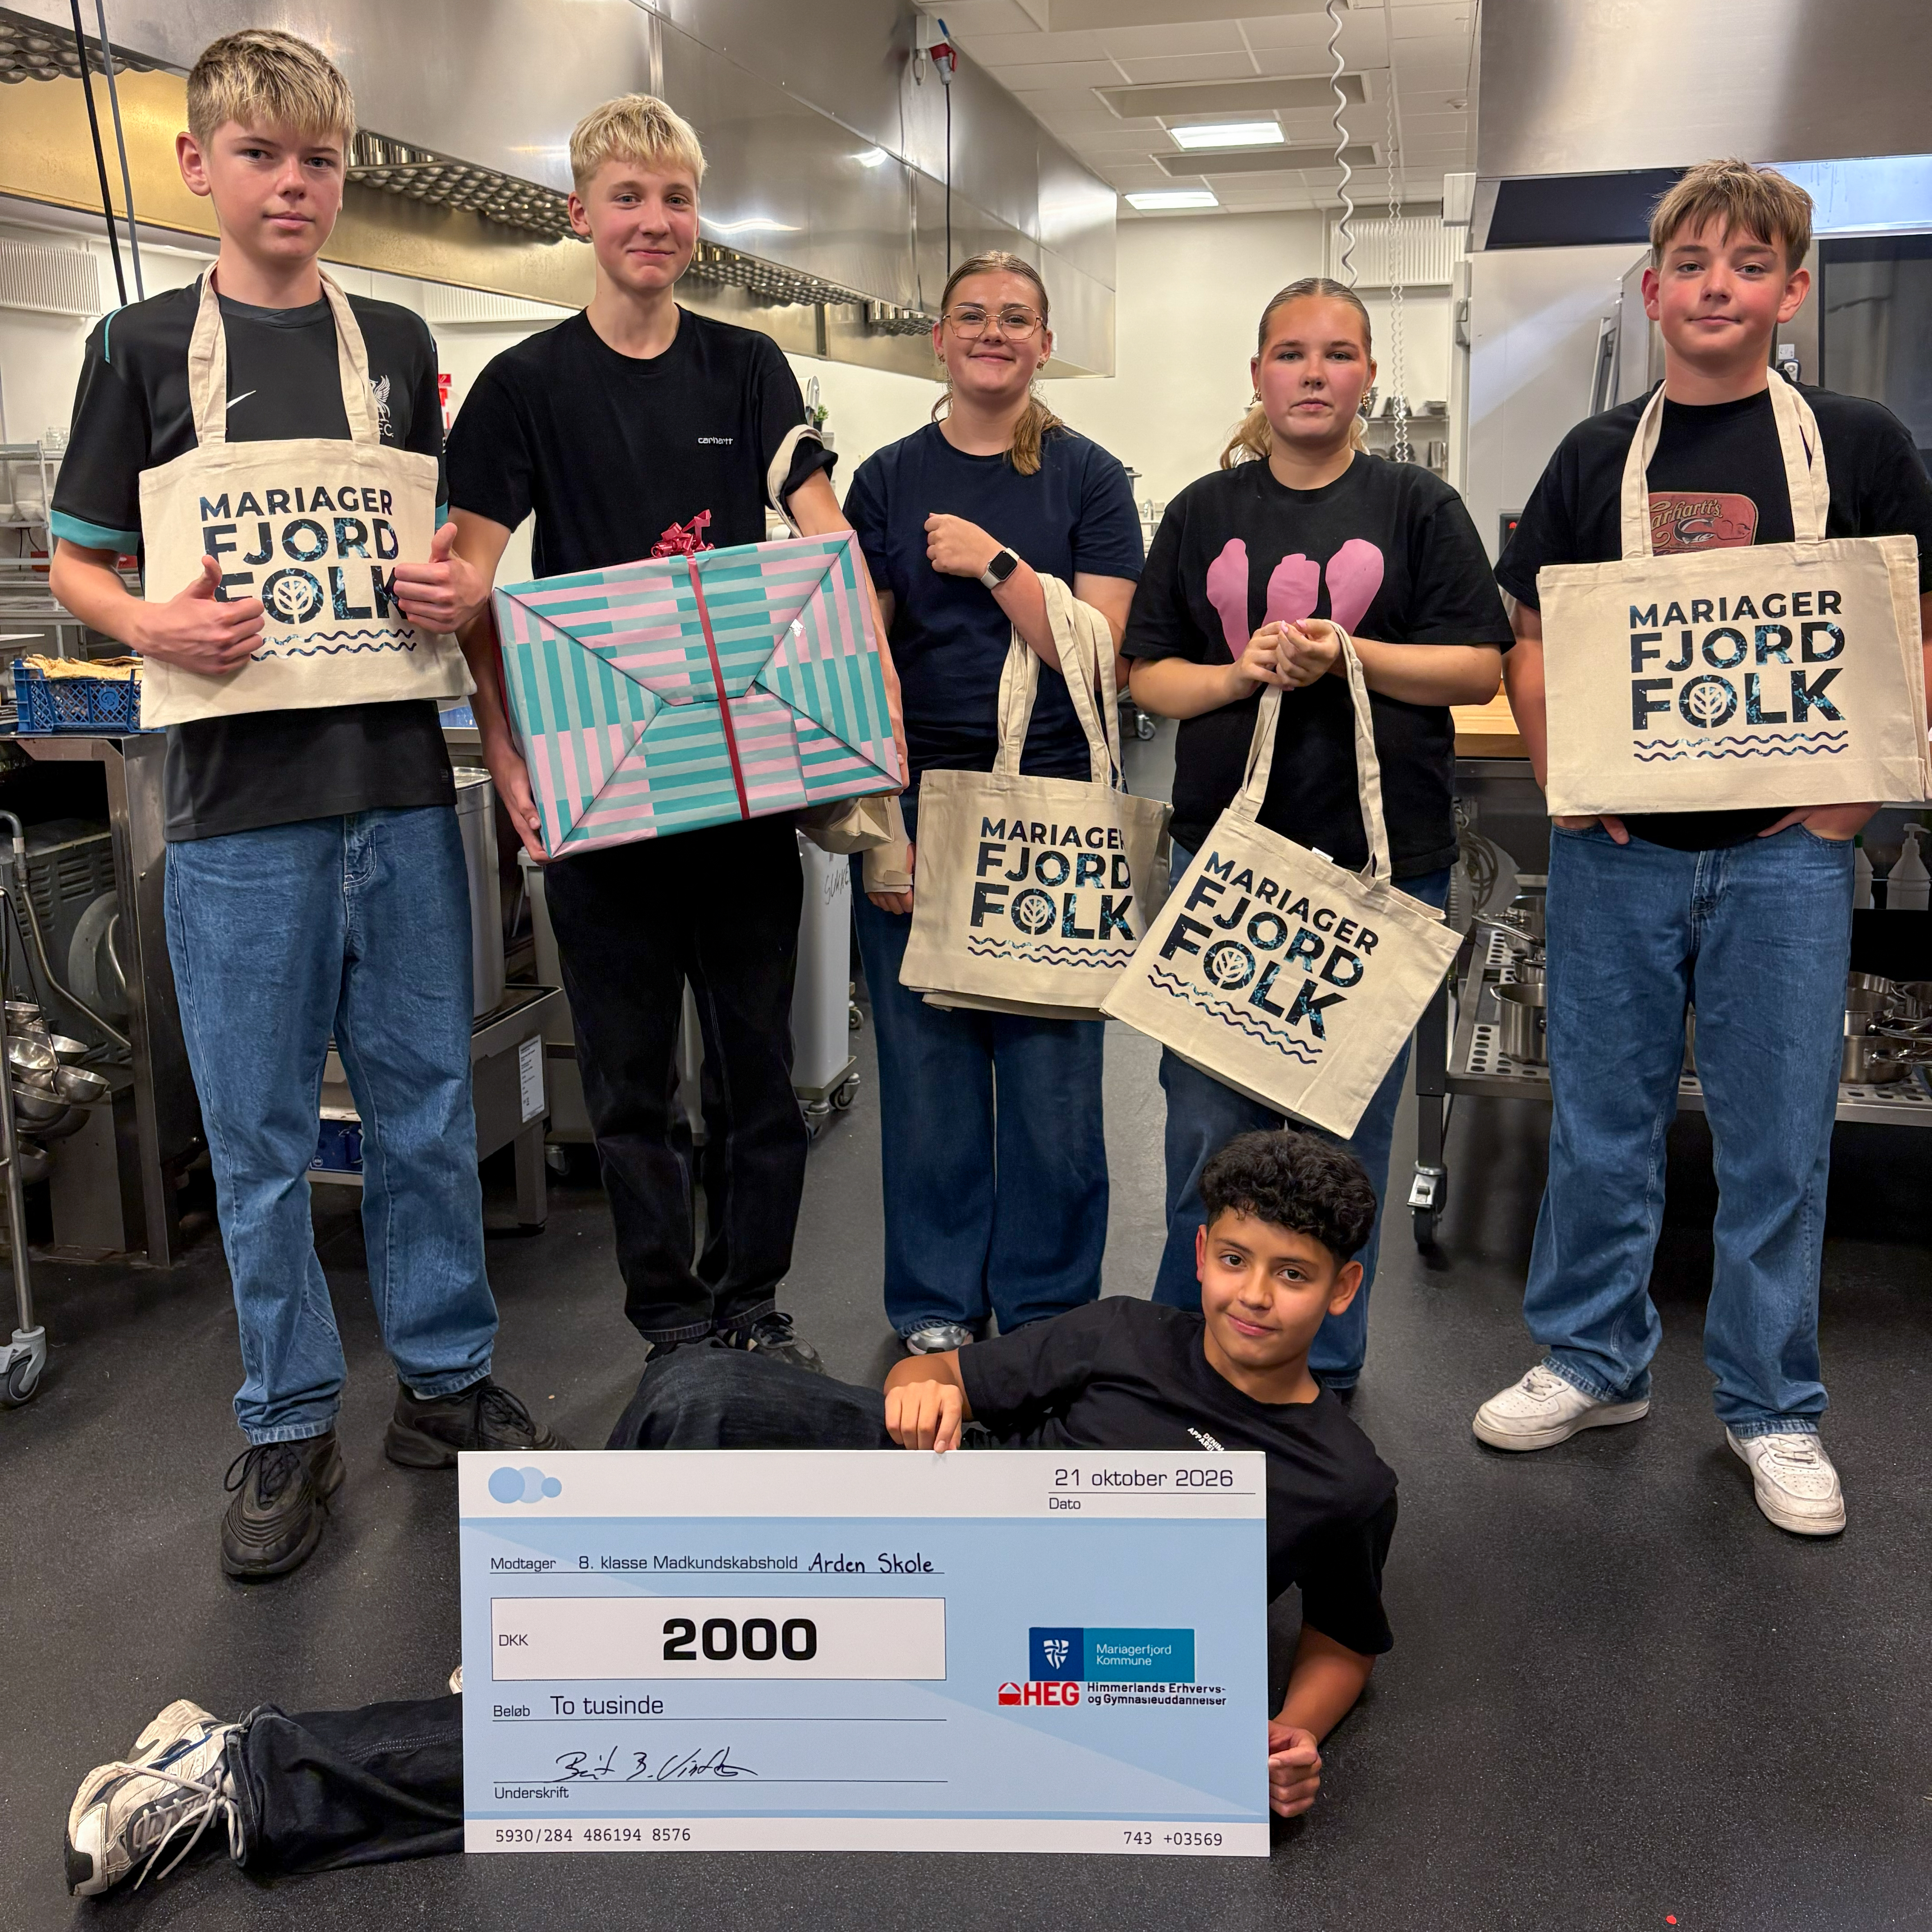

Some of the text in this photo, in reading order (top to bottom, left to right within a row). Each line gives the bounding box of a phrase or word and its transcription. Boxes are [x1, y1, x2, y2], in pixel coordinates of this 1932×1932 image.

[698, 436, 733, 445] carhartt
[199, 486, 392, 521] MARIAGER
[203, 517, 399, 565] FJORD
[1629, 590, 1842, 629] MARIAGER
[1630, 621, 1845, 674] FJORD
[1631, 668, 1846, 730] FOLK
[976, 842, 1132, 890] FJORD
[970, 881, 1137, 941] FOLK
[1204, 851, 1379, 956] MARIAGER
[1184, 875, 1364, 988] FJORD
[1159, 913, 1348, 1042] FOLK
[1203, 1432, 1225, 1451] DENIM
[1055, 1469, 1233, 1487] 21 oktober 2026
[1049, 1497, 1081, 1510] Dato
[491, 1552, 934, 1574] Modtager 8. klasse Madkundskabshold Arden Skole
[499, 1634, 529, 1647] DKK
[662, 1618, 818, 1661] 2000
[1096, 1644, 1172, 1655] Mariagerfjord
[1096, 1655, 1152, 1666] Kommune
[1024, 1682, 1080, 1706] HEG
[1087, 1682, 1226, 1693] Himmerlands Erhvervs-
[494, 1695, 664, 1717] Beløb To tusinde
[1088, 1696, 1101, 1706] og
[494, 1786, 570, 1799] Underskrift
[496, 1828, 691, 1844] 5930/284 486194 8576
[1123, 1831, 1223, 1846] 743 +03569
